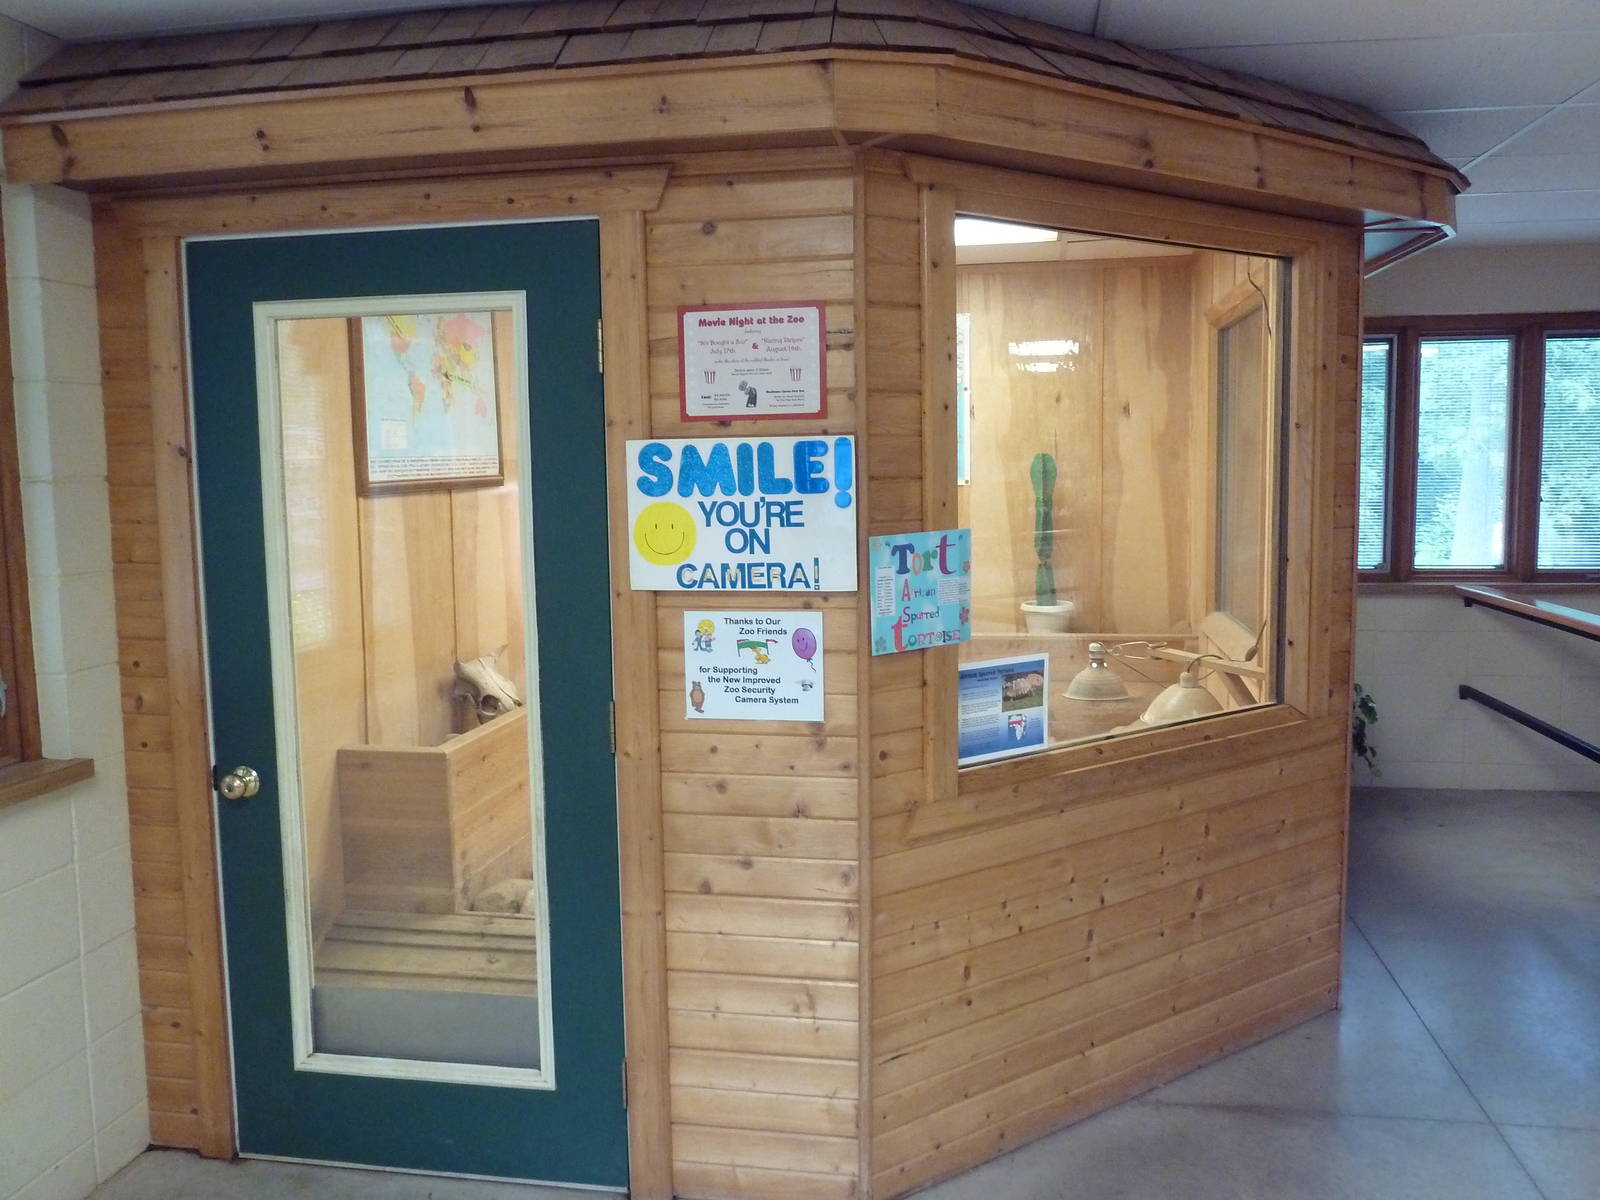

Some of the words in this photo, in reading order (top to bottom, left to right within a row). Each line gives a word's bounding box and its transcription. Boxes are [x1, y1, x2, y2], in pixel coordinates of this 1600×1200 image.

[698, 316, 726, 328] Movie
[729, 316, 754, 328] Night
[757, 316, 766, 325] at
[768, 315, 784, 325] the
[787, 315, 805, 324] Zoo
[752, 342, 759, 350] &
[636, 437, 852, 508] SMILE!
[697, 497, 805, 527] YOU'RE
[724, 528, 771, 555] ON
[676, 557, 820, 590] CAMERA!
[902, 606, 940, 624] Spurred
[723, 617, 754, 626] Thanks
[755, 617, 764, 626] to
[765, 617, 782, 626] Our
[739, 627, 755, 635] Zoo
[756, 627, 788, 636] Friends
[699, 665, 711, 674] for
[712, 665, 758, 675] Supporting
[707, 675, 721, 683] the
[722, 676, 741, 684] New
[742, 676, 781, 686] Improved
[723, 685, 740, 694] Zoo
[741, 685, 776, 695] Security
[734, 695, 767, 704] Camera
[768, 695, 799, 706] System
